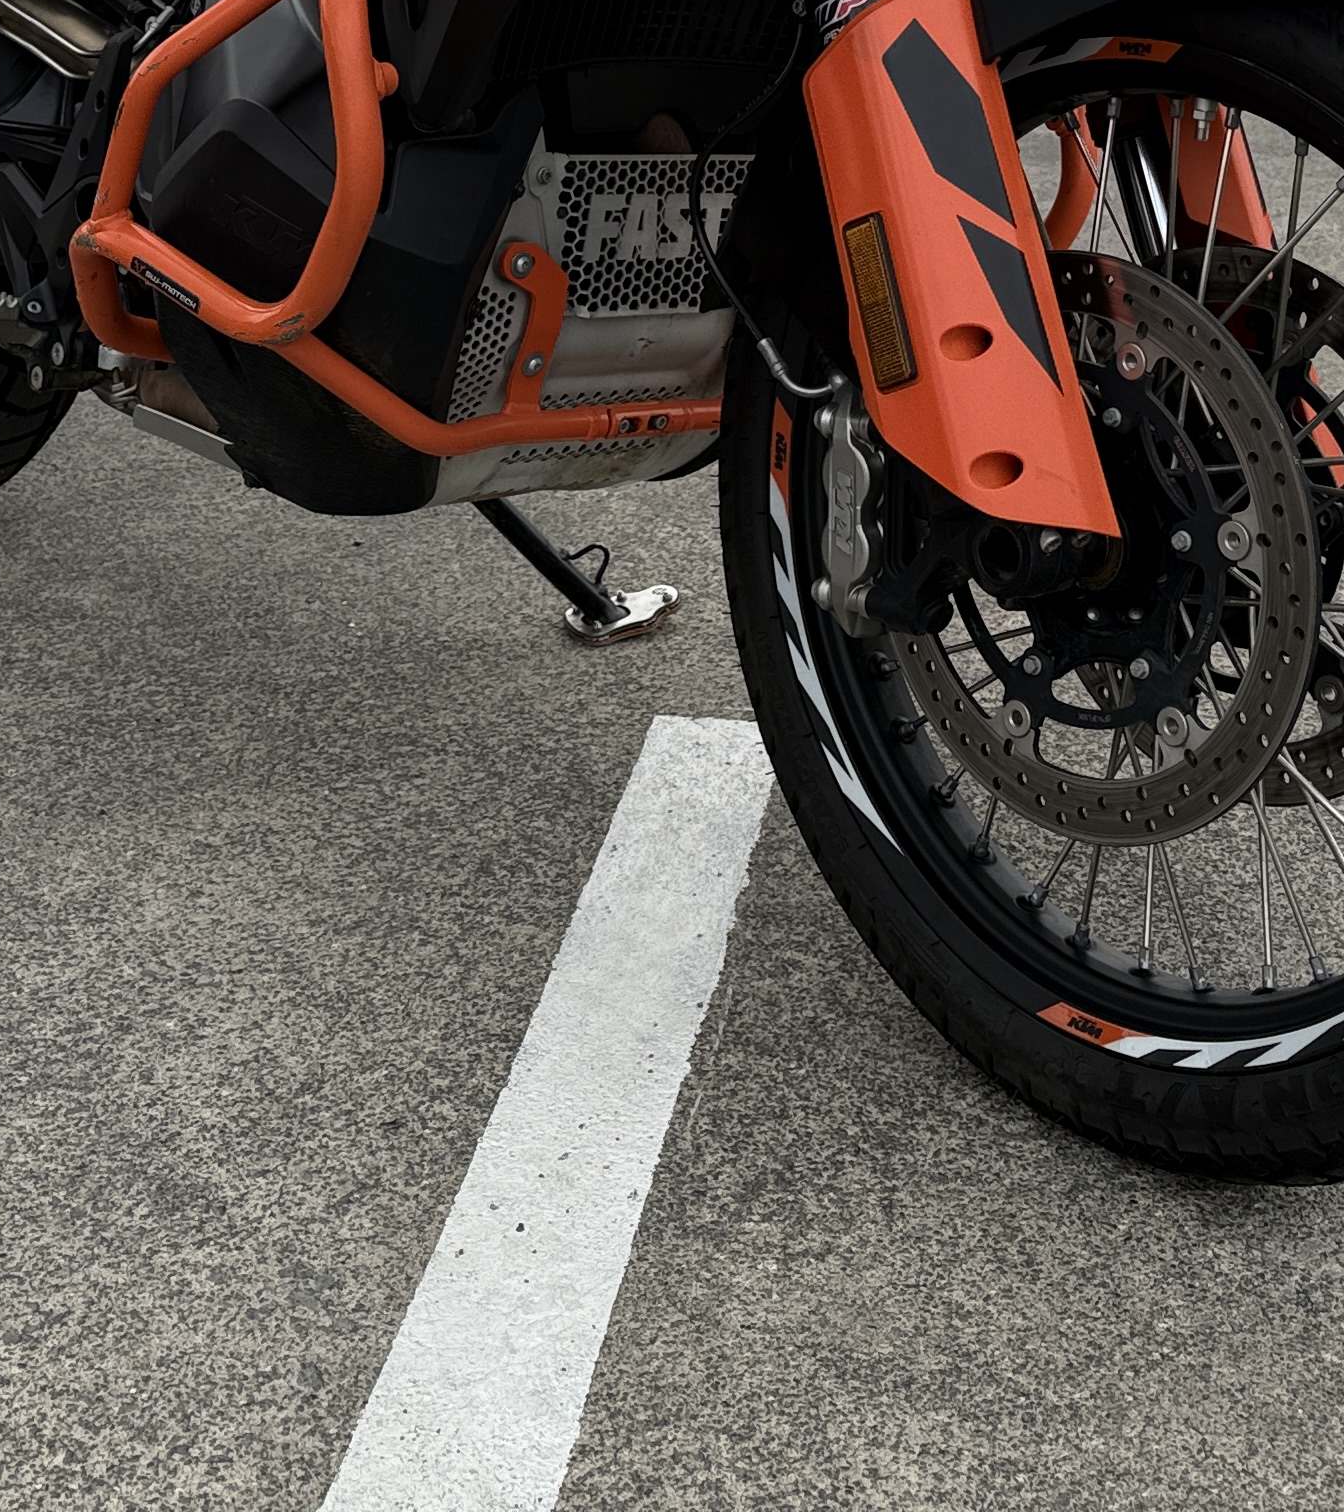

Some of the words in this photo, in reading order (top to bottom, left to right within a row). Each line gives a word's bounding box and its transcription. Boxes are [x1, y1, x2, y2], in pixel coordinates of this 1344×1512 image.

[1119, 41, 1152, 57] KTM
[581, 191, 740, 263] FAST
[144, 270, 197, 309] SW-MOTECH
[775, 432, 787, 470] KTM
[1067, 1016, 1103, 1039] KTM
